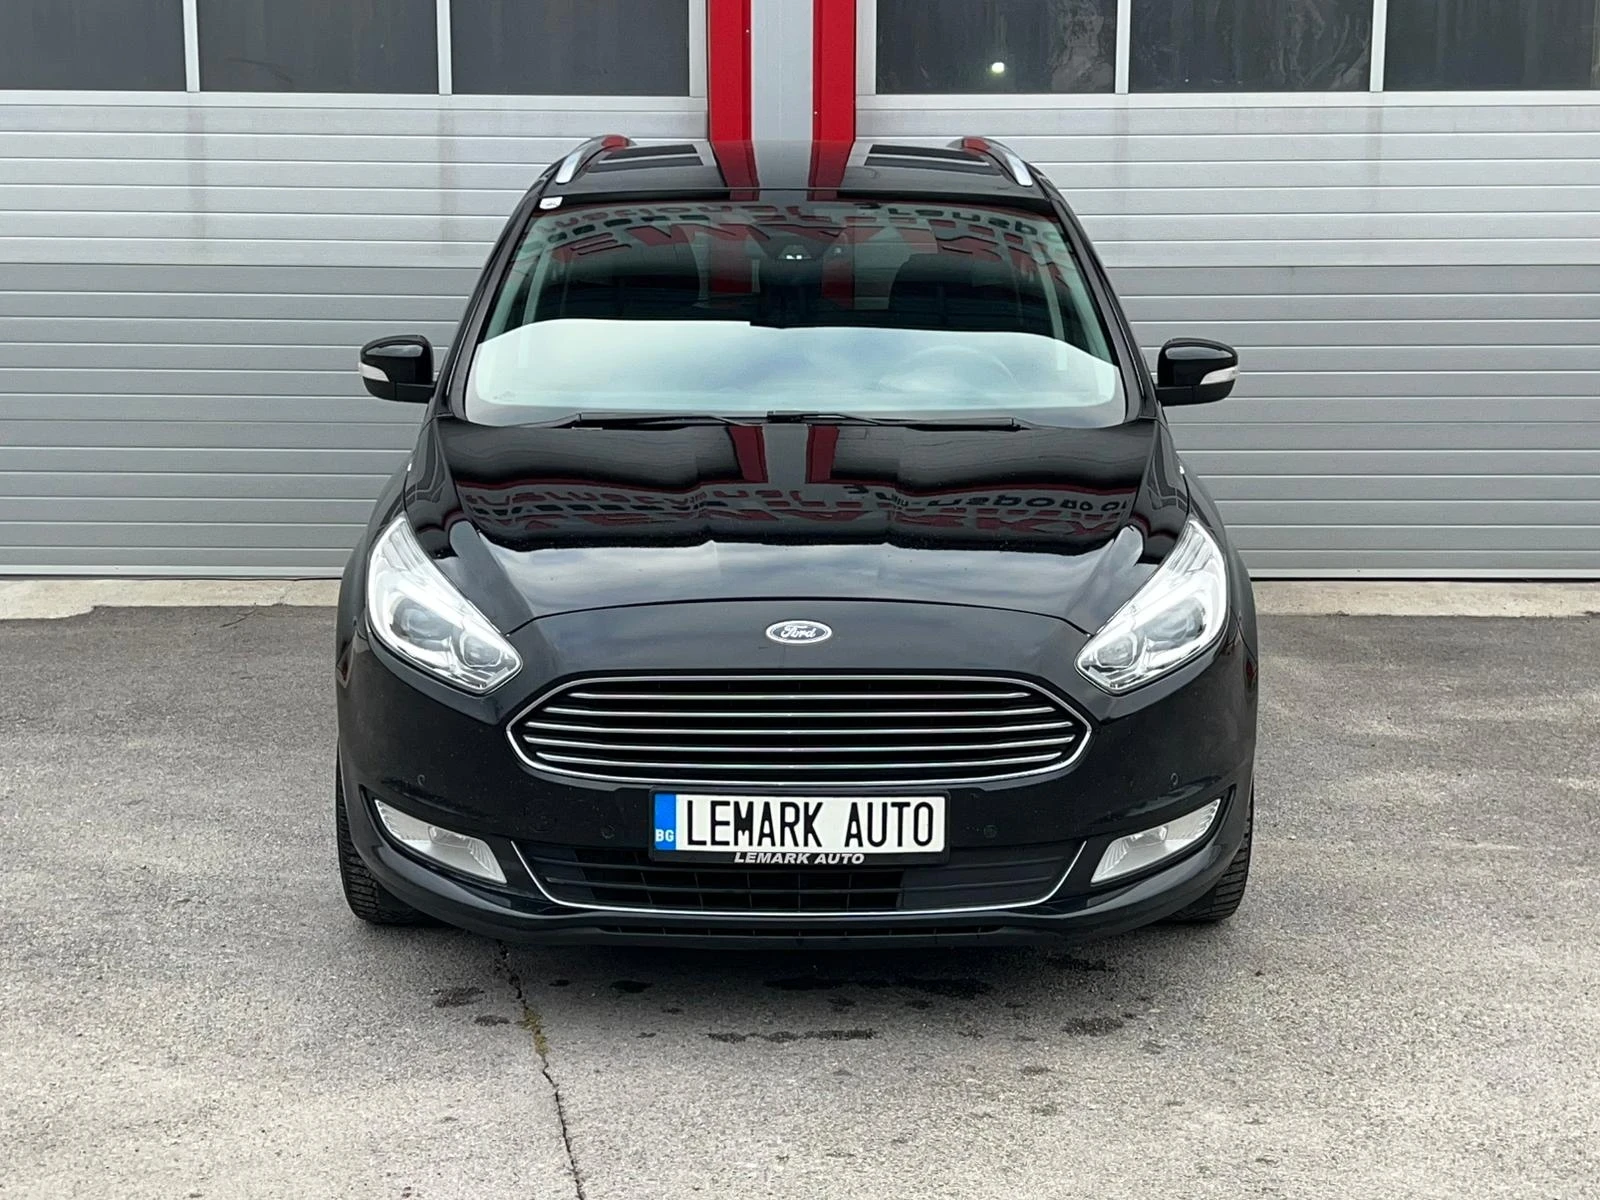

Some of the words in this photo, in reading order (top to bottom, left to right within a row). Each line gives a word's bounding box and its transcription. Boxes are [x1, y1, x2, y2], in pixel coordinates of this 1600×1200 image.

[780, 624, 817, 638] Ford
[686, 799, 823, 848] LEMARK
[843, 801, 934, 848] AUTO
[655, 828, 675, 843] BG
[733, 852, 811, 865] LEMARK
[813, 853, 865, 866] AUTO
